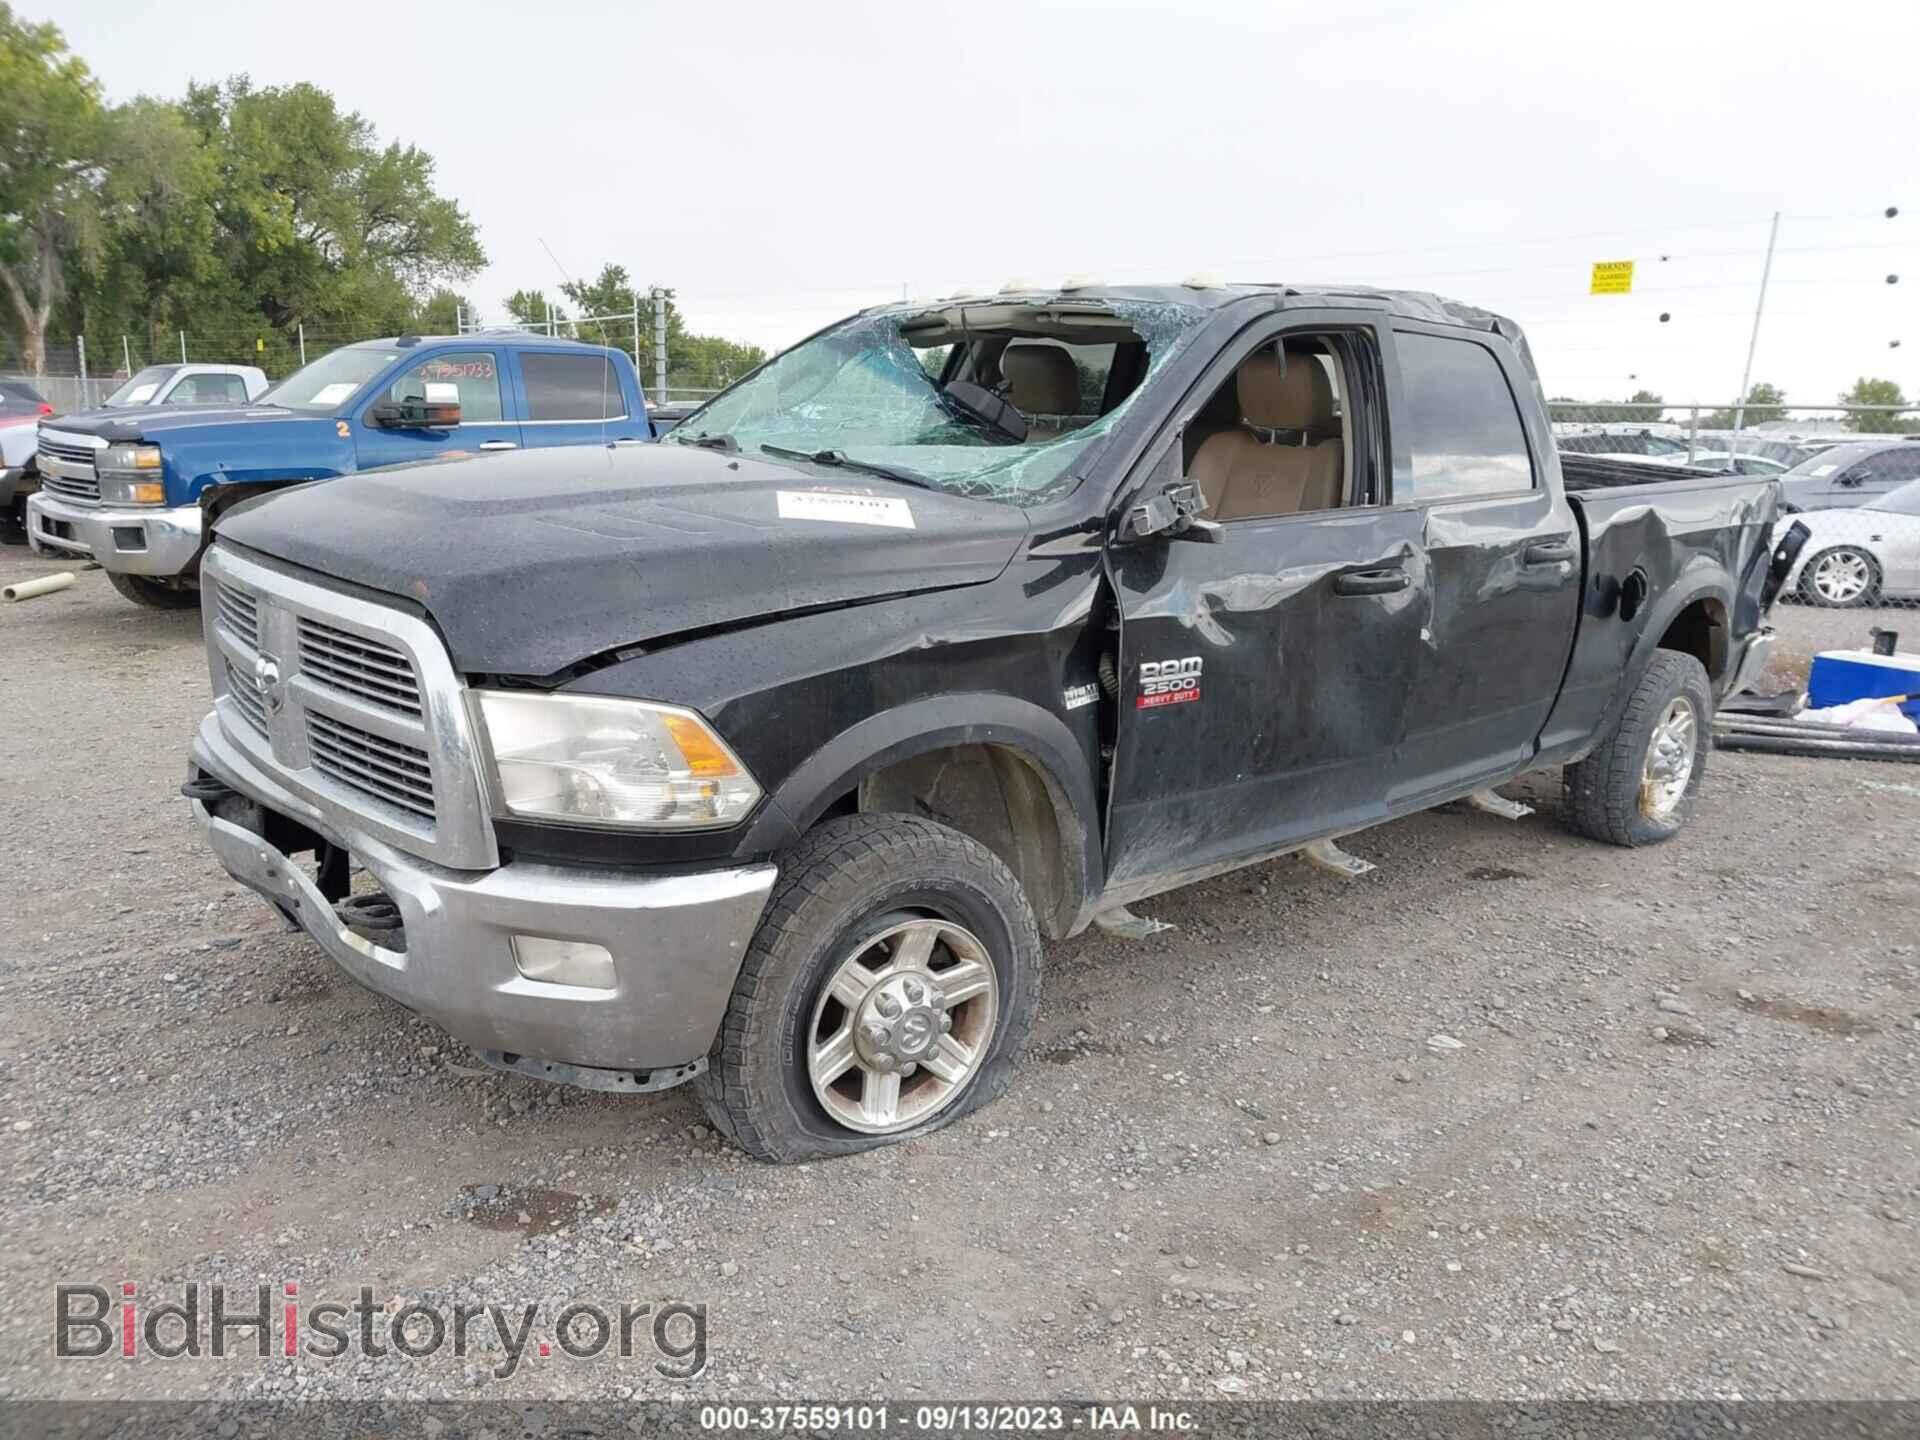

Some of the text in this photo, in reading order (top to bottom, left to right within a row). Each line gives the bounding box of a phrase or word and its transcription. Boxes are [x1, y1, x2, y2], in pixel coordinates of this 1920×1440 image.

[336, 421, 351, 437] 2
[1139, 656, 1203, 681] RAM
[1143, 678, 1196, 695] 2500
[1143, 690, 1194, 705] HEAVY DUTY
